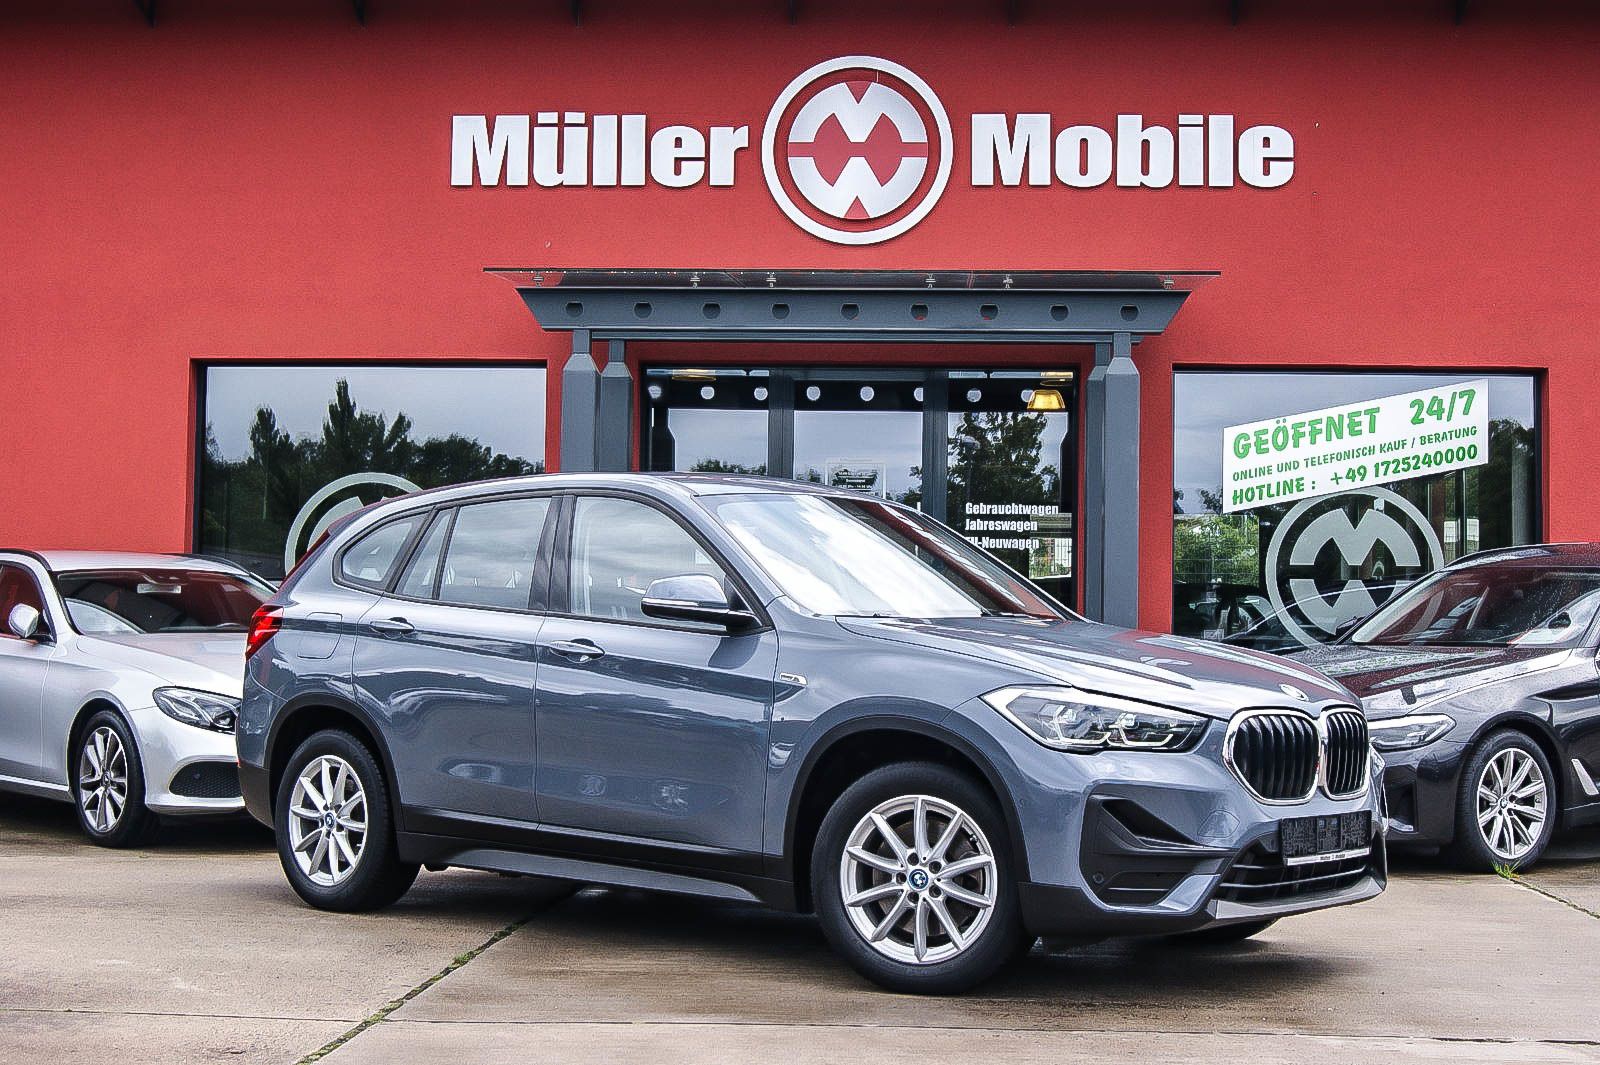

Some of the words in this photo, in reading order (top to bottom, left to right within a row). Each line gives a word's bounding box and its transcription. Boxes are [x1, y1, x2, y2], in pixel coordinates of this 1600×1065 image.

[450, 111, 749, 189] Müller
[970, 112, 1295, 190] Mobile
[1233, 407, 1380, 459] GEÖFFNET
[1409, 389, 1476, 426] 24/7
[1233, 465, 1273, 482] ONLINE
[1277, 459, 1300, 473] UND
[1304, 445, 1375, 469] TELEFONISCH
[1379, 438, 1408, 454] KAUF
[1420, 425, 1478, 446] BERATUNG
[1232, 476, 1305, 506] HOTLINE
[1330, 465, 1367, 485] +49
[1374, 444, 1478, 478] 1725240000
[965, 502, 1059, 516] Gebrauchtwagen
[965, 518, 1038, 532] Jahreswagen
